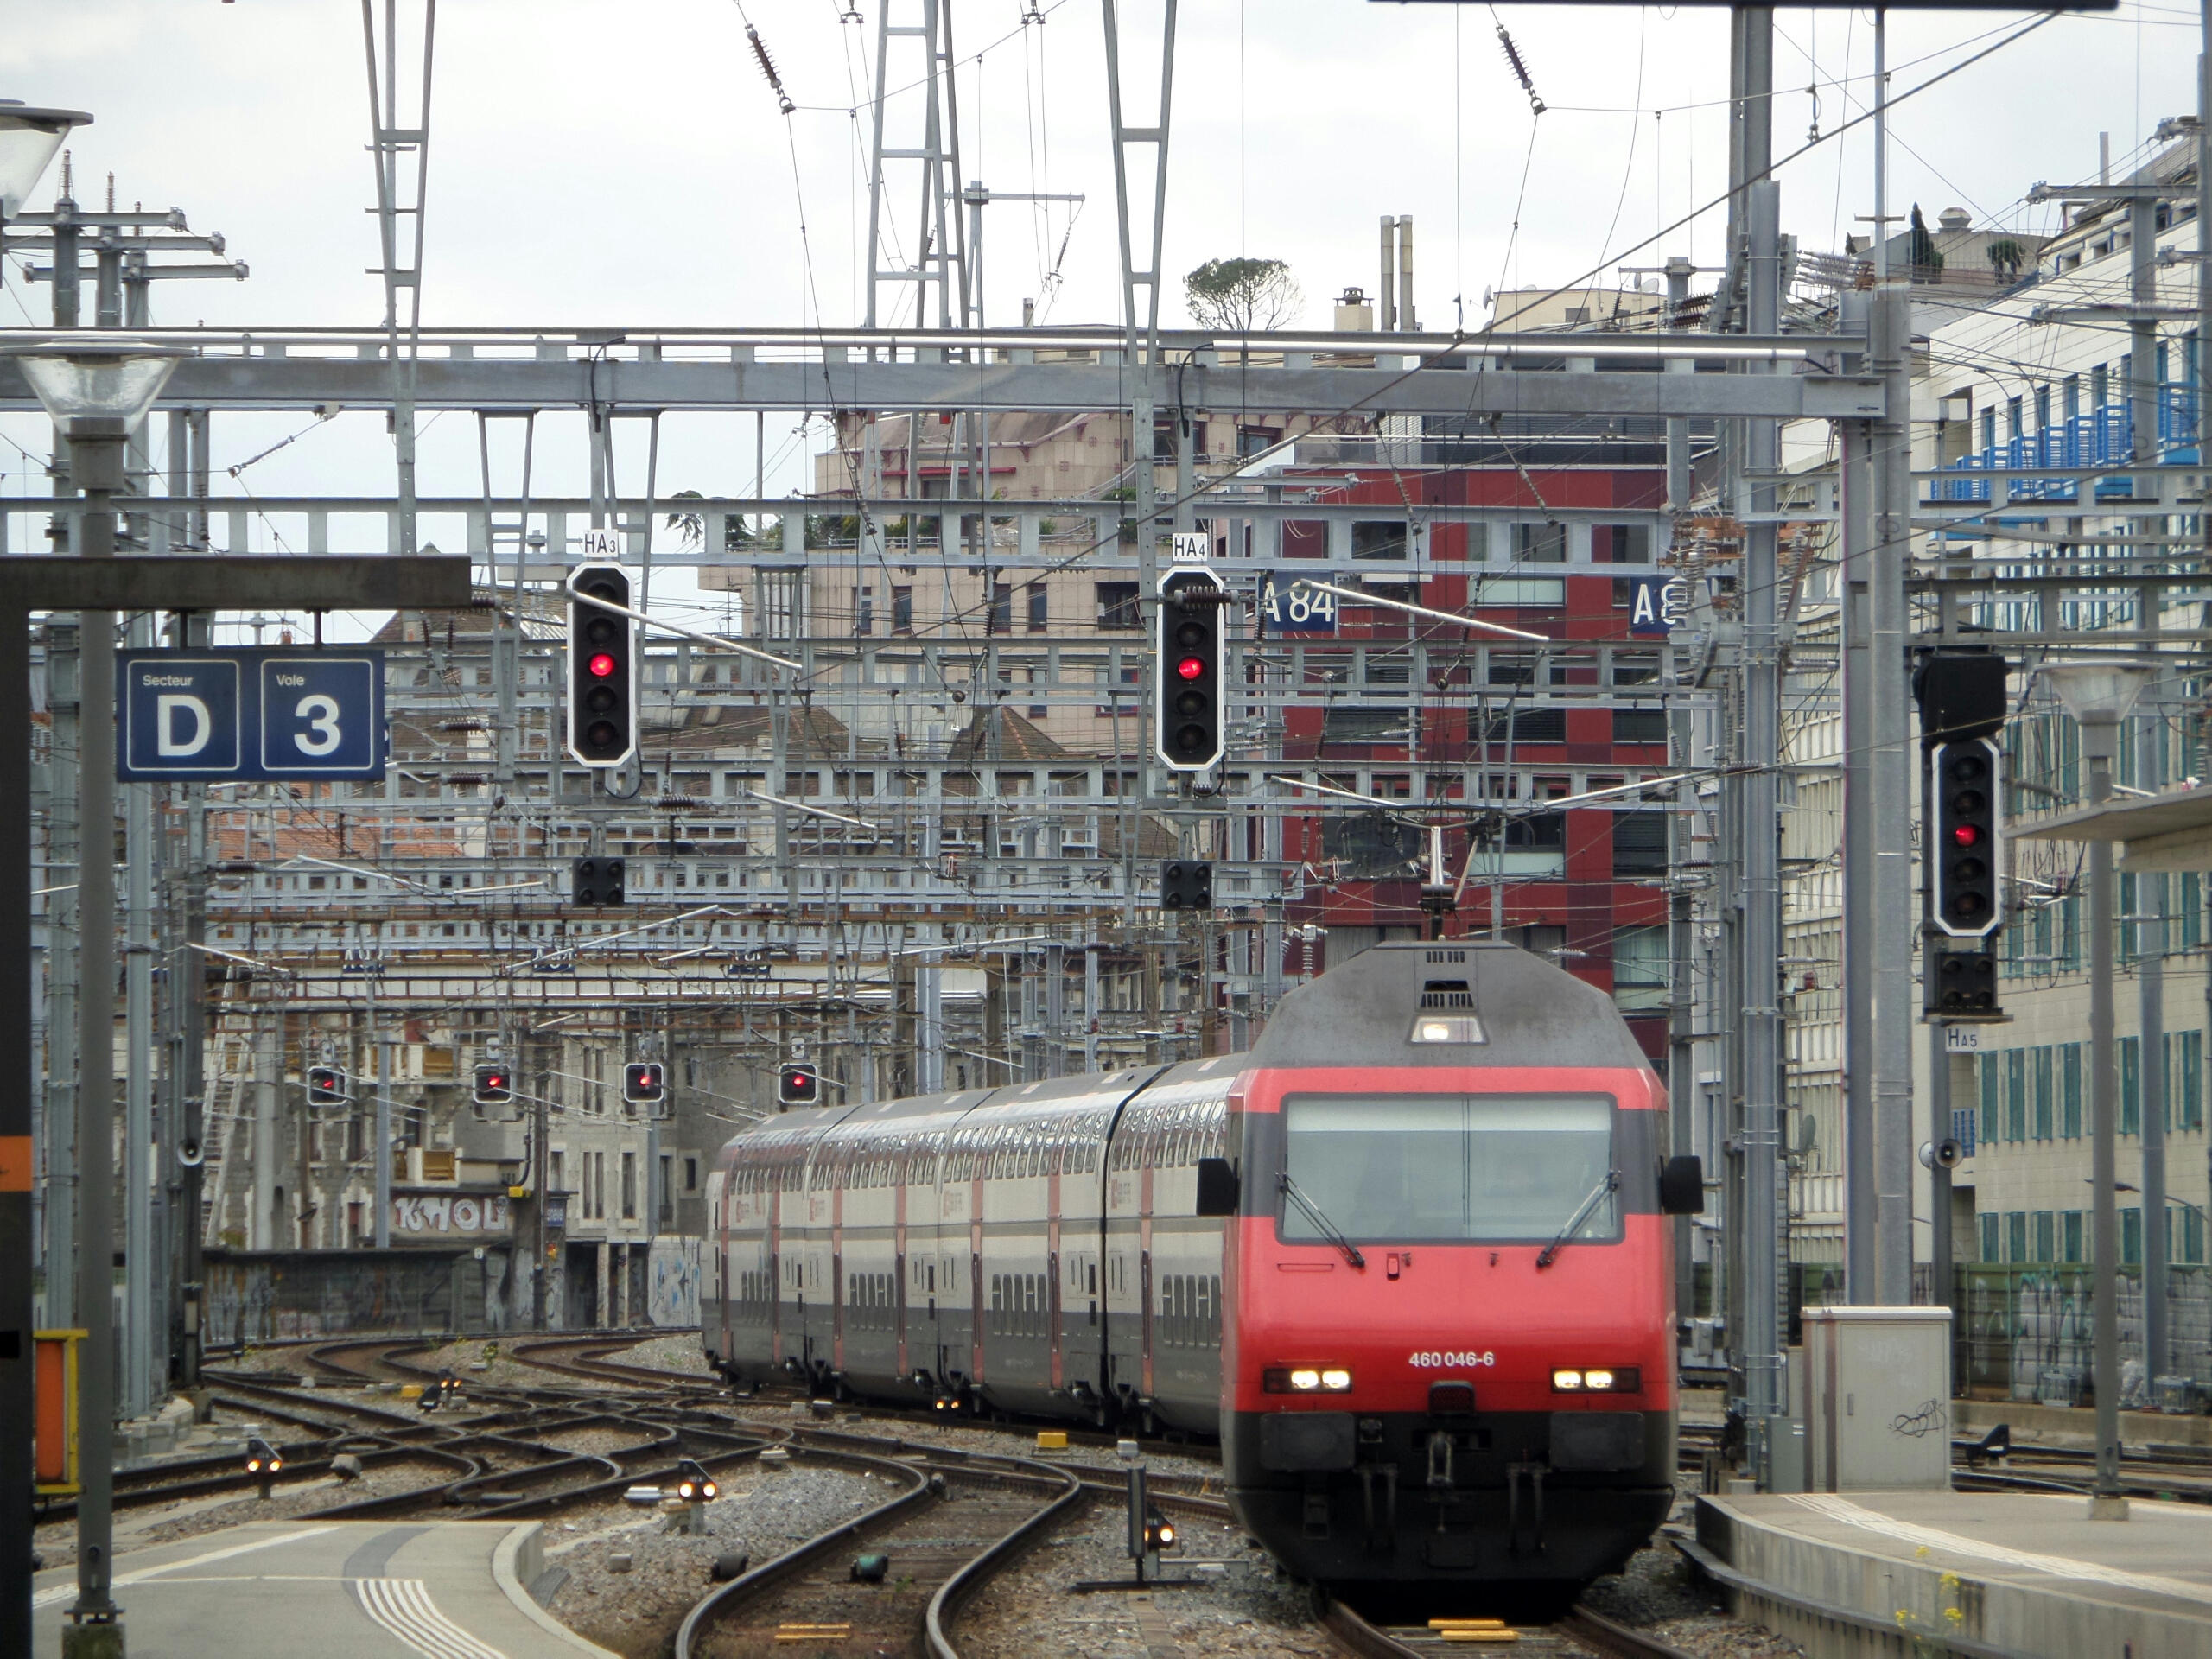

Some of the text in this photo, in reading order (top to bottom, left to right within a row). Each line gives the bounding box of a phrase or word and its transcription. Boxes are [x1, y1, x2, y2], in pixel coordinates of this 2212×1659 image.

[584, 533, 616, 554] HA3
[1174, 537, 1205, 557] HA4
[142, 674, 193, 687] Secteur
[276, 674, 304, 686] Voie
[157, 695, 211, 756] D
[294, 695, 341, 756] 3
[1408, 1351, 1494, 1367] 460 046-6
